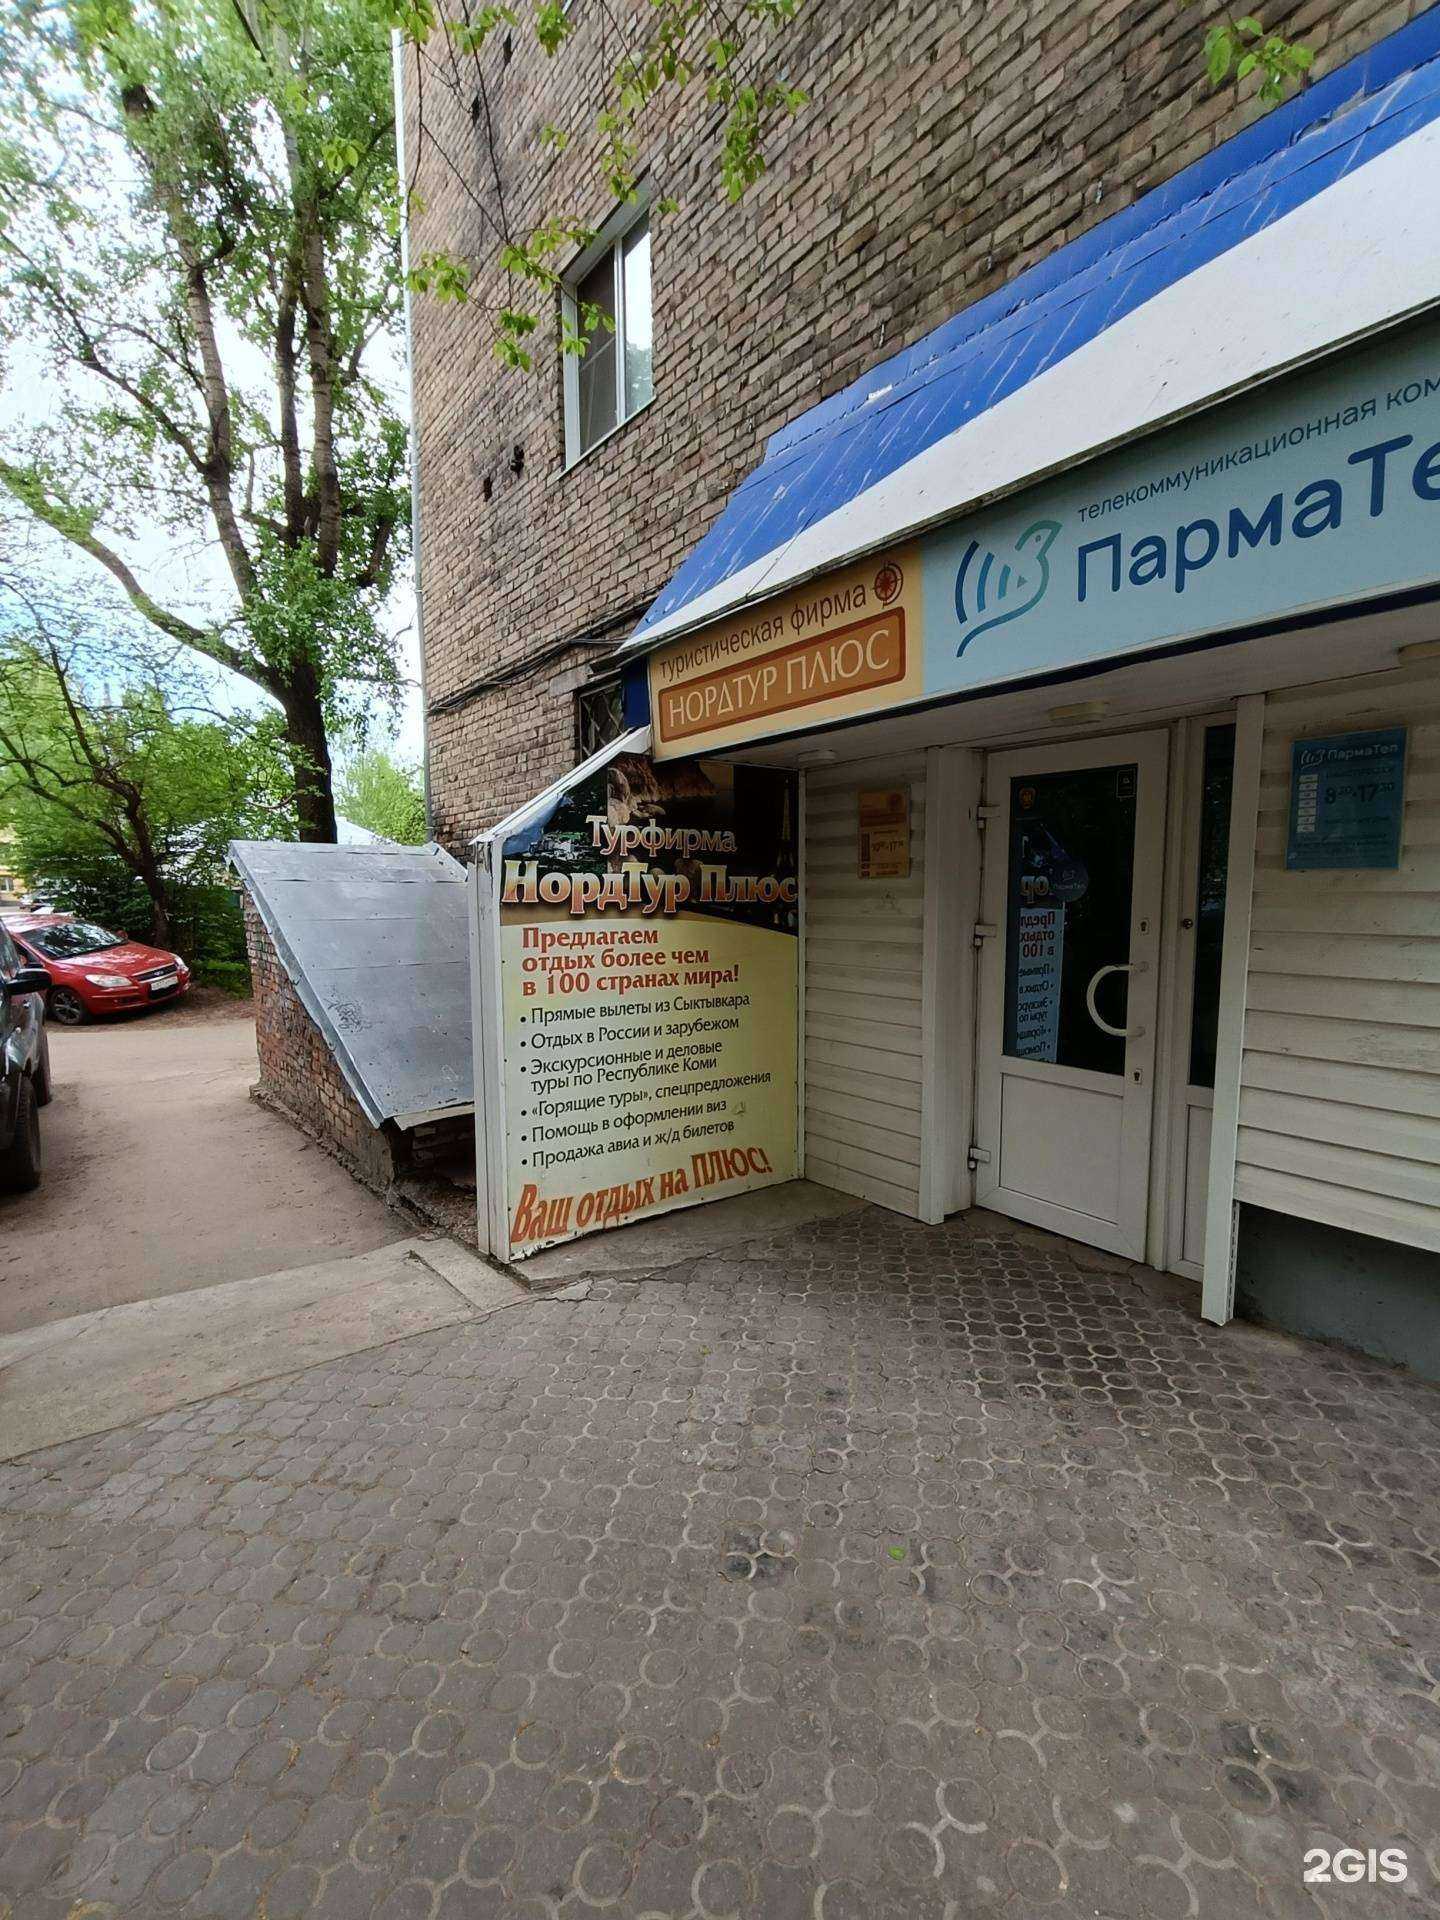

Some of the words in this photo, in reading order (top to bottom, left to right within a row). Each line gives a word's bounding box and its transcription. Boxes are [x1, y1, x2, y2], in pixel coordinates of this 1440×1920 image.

[1077, 398, 1376, 523] телекоммуникационная
[660, 615, 784, 682] туристическая
[791, 585, 866, 633] фирма
[669, 666, 777, 727] НОРДТУР
[787, 630, 889, 694] ПЛЮС
[586, 815, 737, 858] Турфирма
[502, 860, 691, 914] НордТур
[700, 864, 798, 903] Плюс
[522, 927, 659, 953] Предлагаем
[522, 953, 595, 975] отдых
[601, 946, 666, 967] более
[671, 949, 710, 965] чем
[523, 981, 536, 996] в
[547, 972, 590, 996] 100
[597, 972, 679, 995] странах
[684, 965, 739, 989] мира!
[531, 1008, 595, 1026] Прямые
[600, 1000, 651, 1017] вылеты
[655, 999, 670, 1012] из
[674, 994, 750, 1012] Сыктывкара
[531, 1032, 582, 1050] Отдых
[586, 1032, 594, 1044] в
[599, 1025, 650, 1042] России
[654, 1026, 662, 1036] и
[666, 1018, 740, 1036] зарубежом
[530, 1048, 651, 1076] Экскурсионные
[654, 1048, 664, 1059] и
[667, 1041, 722, 1060] деловые
[531, 1078, 570, 1095] туры
[573, 1073, 593, 1086] по
[598, 1059, 679, 1082] Республике
[684, 1056, 717, 1070] Коми
[532, 1095, 605, 1118] «Горящие
[608, 1090, 652, 1109] туры»,
[655, 1071, 771, 1097] спецпредложения
[532, 1122, 598, 1142] Помощь
[602, 1119, 610, 1130] в
[613, 1105, 704, 1129] оформлении
[706, 1101, 727, 1114] виз
[532, 1144, 604, 1169] Продажа
[607, 1136, 640, 1153] авиа
[643, 1136, 652, 1146] и
[655, 1130, 681, 1145] ж/д
[683, 1121, 734, 1139] билетов
[510, 1184, 573, 1243] Ваш
[576, 1176, 655, 1228] отдых
[659, 1168, 689, 1200] на
[691, 1147, 773, 1189] ПЛЮС!
